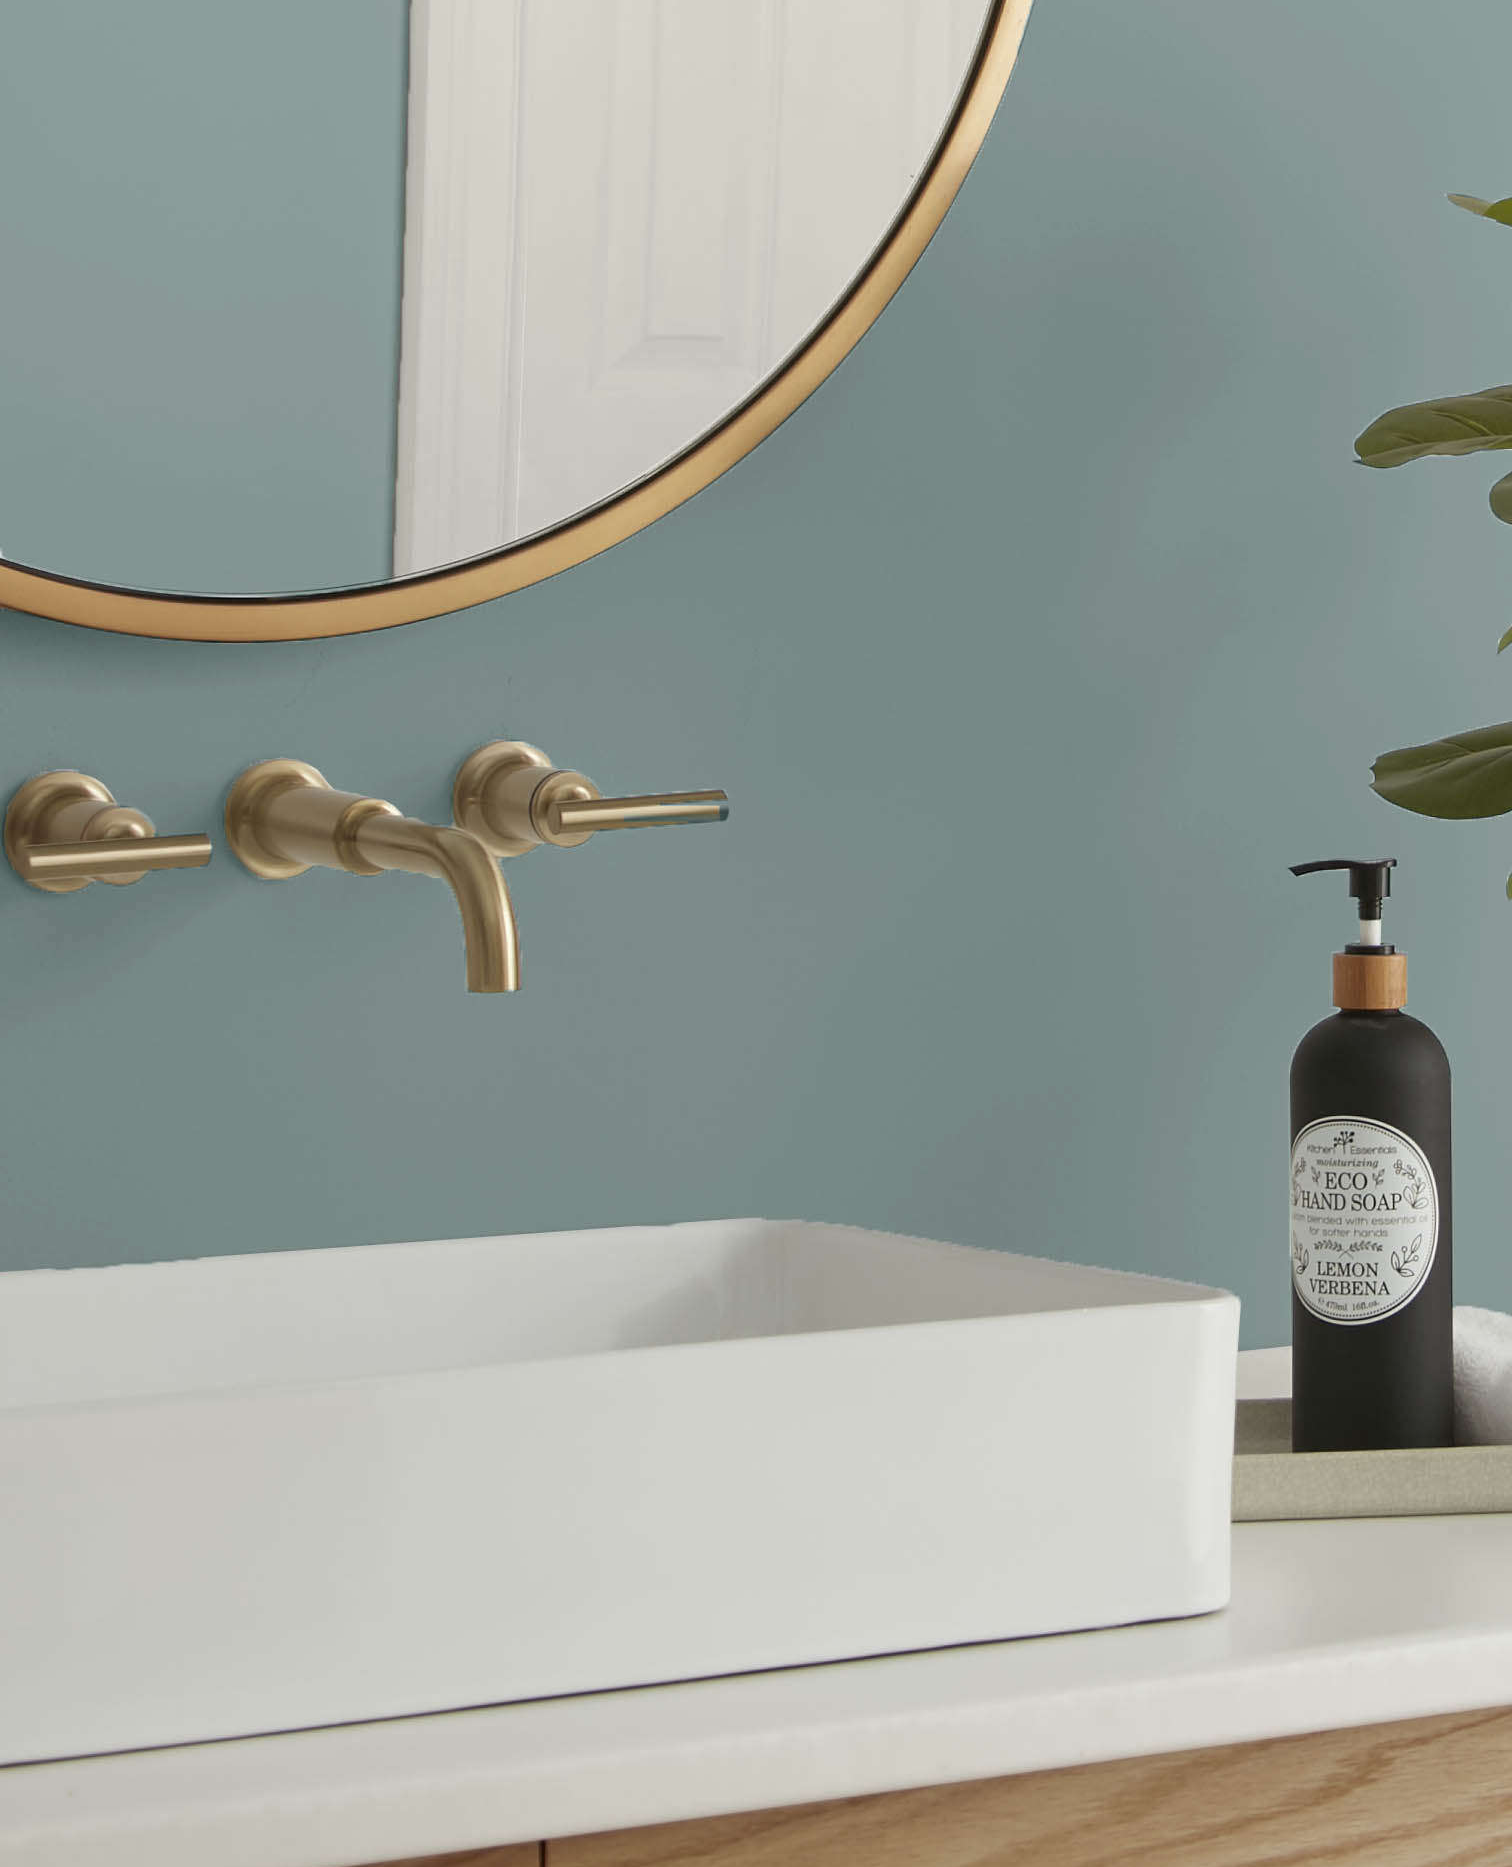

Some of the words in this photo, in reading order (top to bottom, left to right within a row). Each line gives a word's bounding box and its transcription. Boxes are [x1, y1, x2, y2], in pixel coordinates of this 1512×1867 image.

[1350, 1145, 1397, 1155] Essentials
[1316, 1158, 1379, 1169] moisturizing
[1325, 1171, 1368, 1190] ECO
[1300, 1190, 1346, 1211] HAND
[1351, 1193, 1402, 1212] SOAP
[1307, 1214, 1341, 1225] blended
[1345, 1215, 1368, 1226] with
[1371, 1215, 1416, 1226] essential
[1322, 1227, 1350, 1237] softer
[1353, 1227, 1388, 1237] hands
[1317, 1261, 1379, 1277] LEMON
[1309, 1278, 1390, 1295] VERBENA
